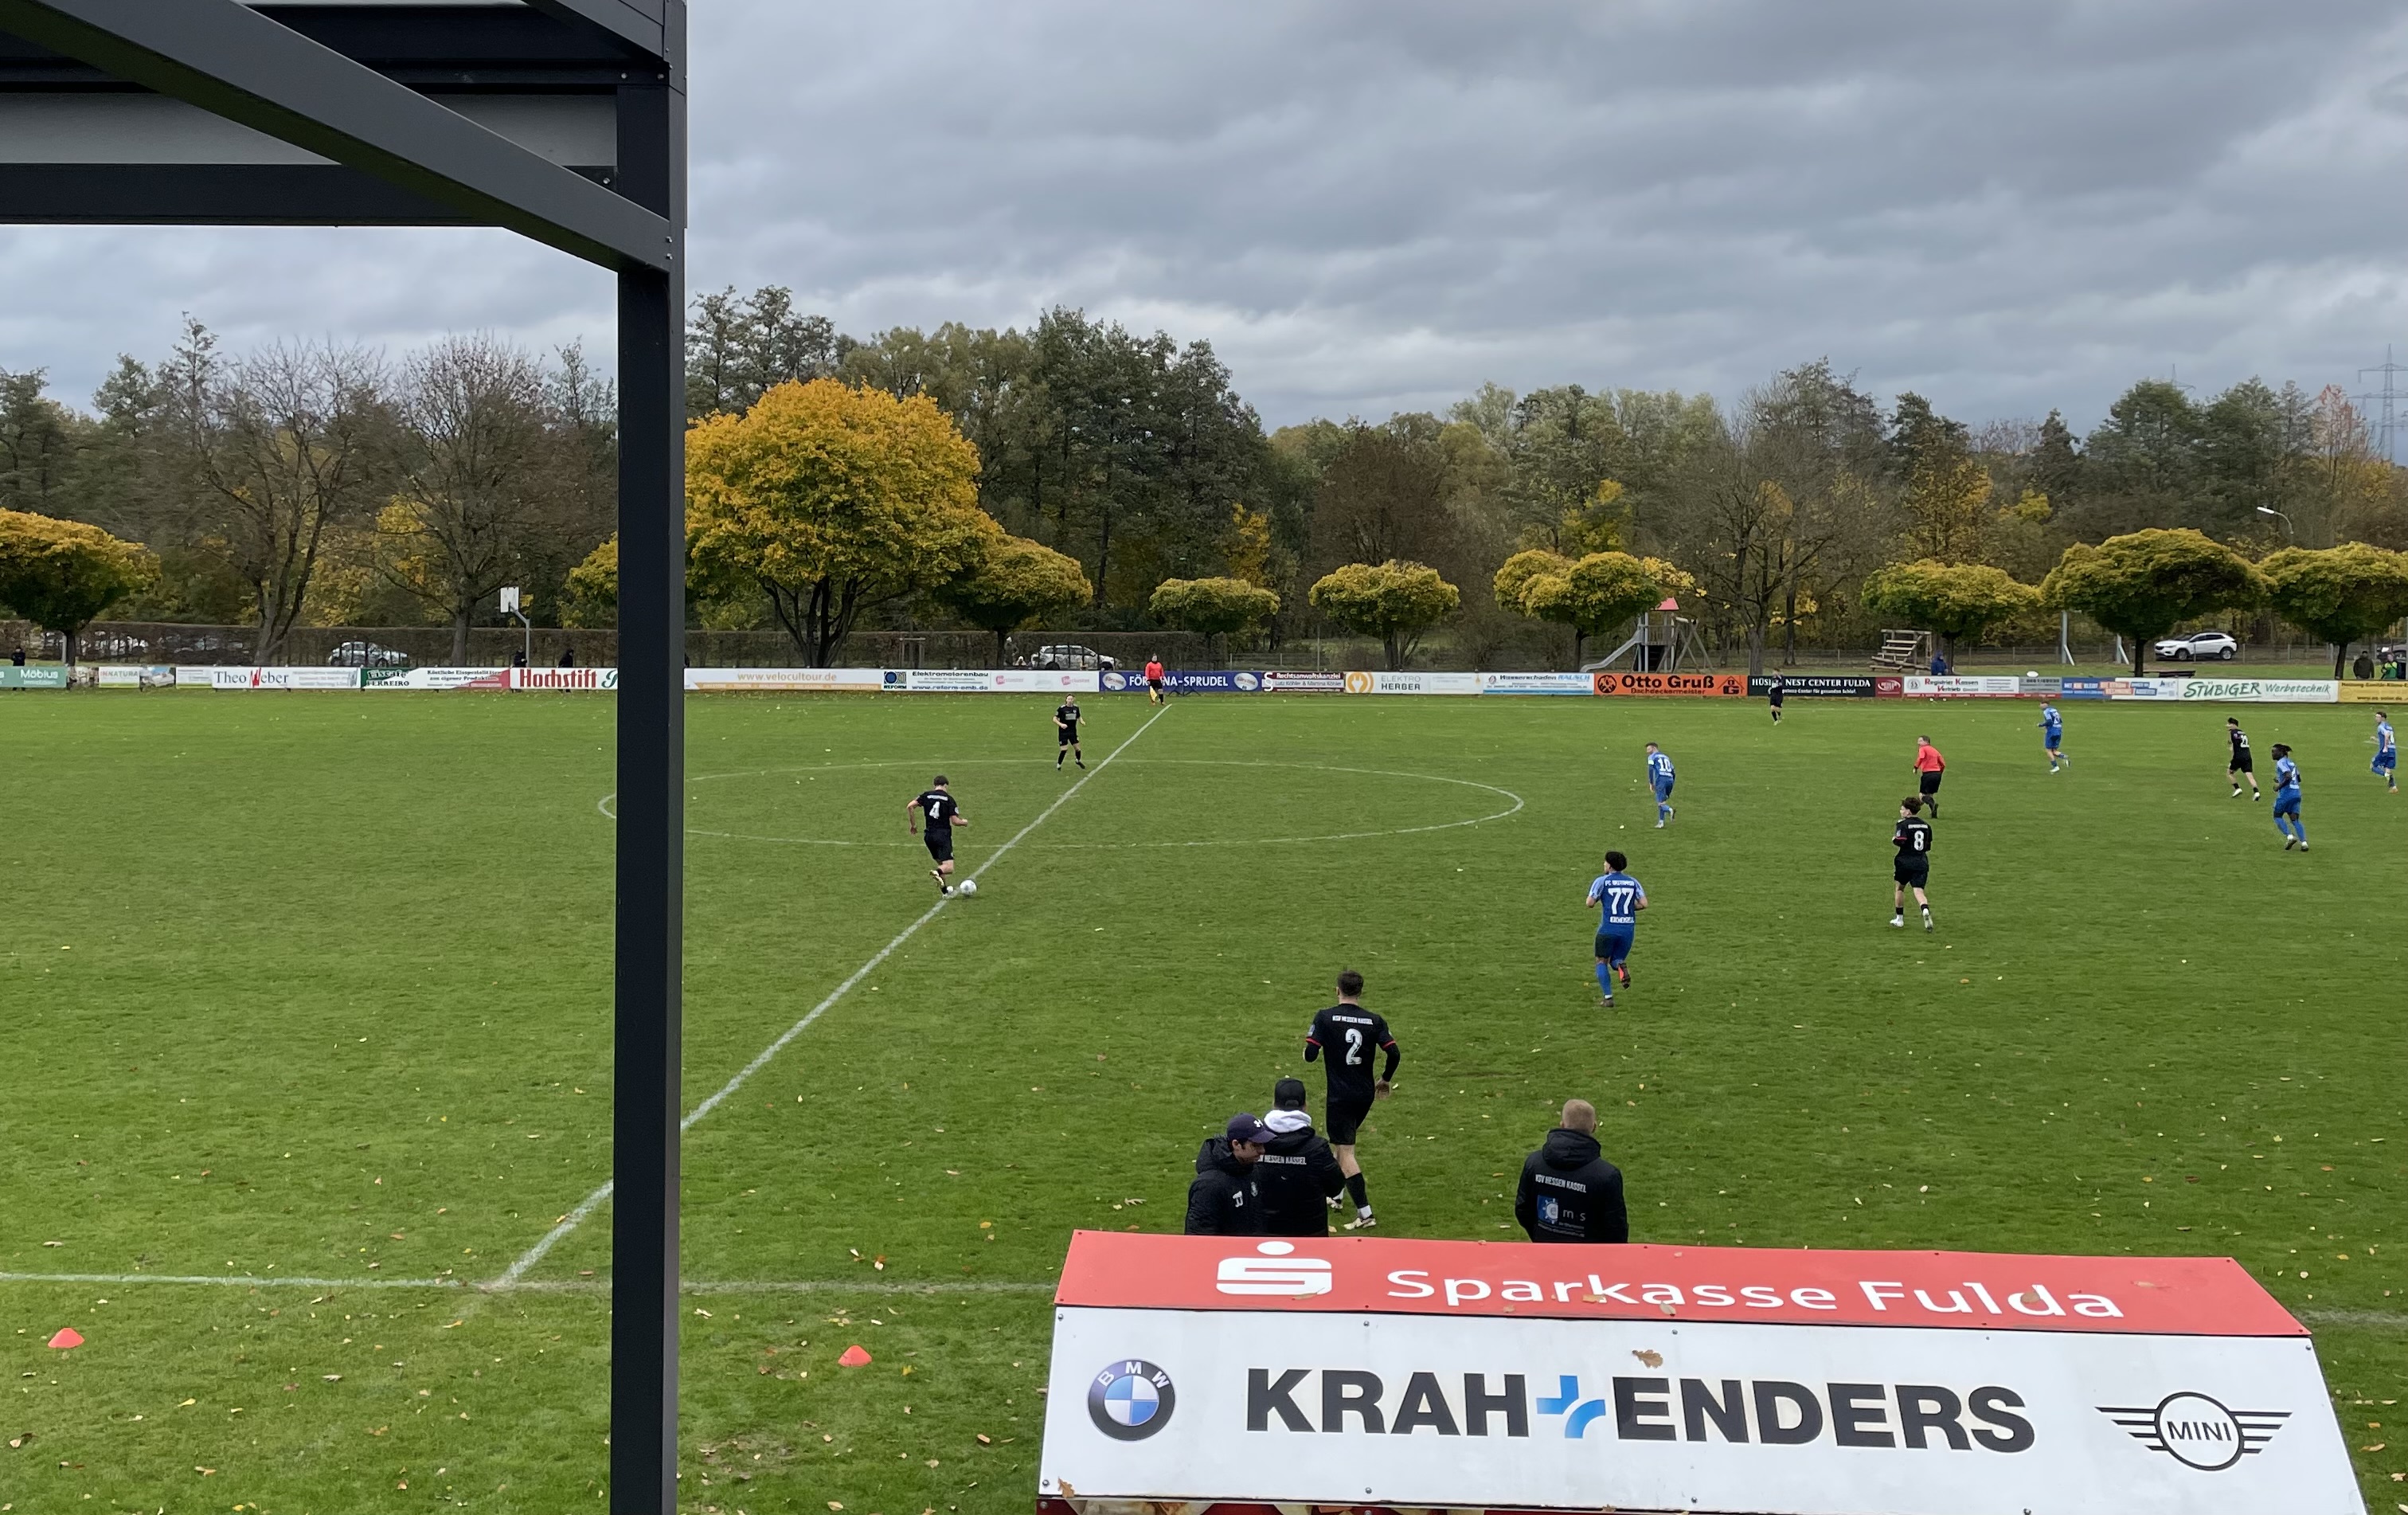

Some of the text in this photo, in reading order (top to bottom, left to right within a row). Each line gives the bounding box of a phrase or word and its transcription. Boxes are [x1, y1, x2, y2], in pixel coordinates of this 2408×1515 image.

[20, 668, 59, 679] Möbius
[213, 671, 247, 683] Theo
[519, 668, 597, 688] Hochstift
[737, 671, 837, 682] www.velocultour.de
[1621, 675, 1714, 689] Otto Gruß
[1843, 679, 1870, 687] FULDA
[2183, 681, 2261, 698] STÜBIGER
[2265, 683, 2331, 694] Werbetechnik
[928, 801, 940, 820] 4
[1914, 830, 1924, 851] 8
[1608, 887, 1635, 914] 77
[1345, 1028, 1362, 1066] 2
[1566, 1180, 1587, 1193] KASSEL
[1386, 1270, 2125, 1319] Sparkasse Fulda
[1097, 1361, 1170, 1388] BMW
[1247, 1368, 2036, 1453] KRAH ENDERS
[2166, 1420, 2232, 1442] MINI
